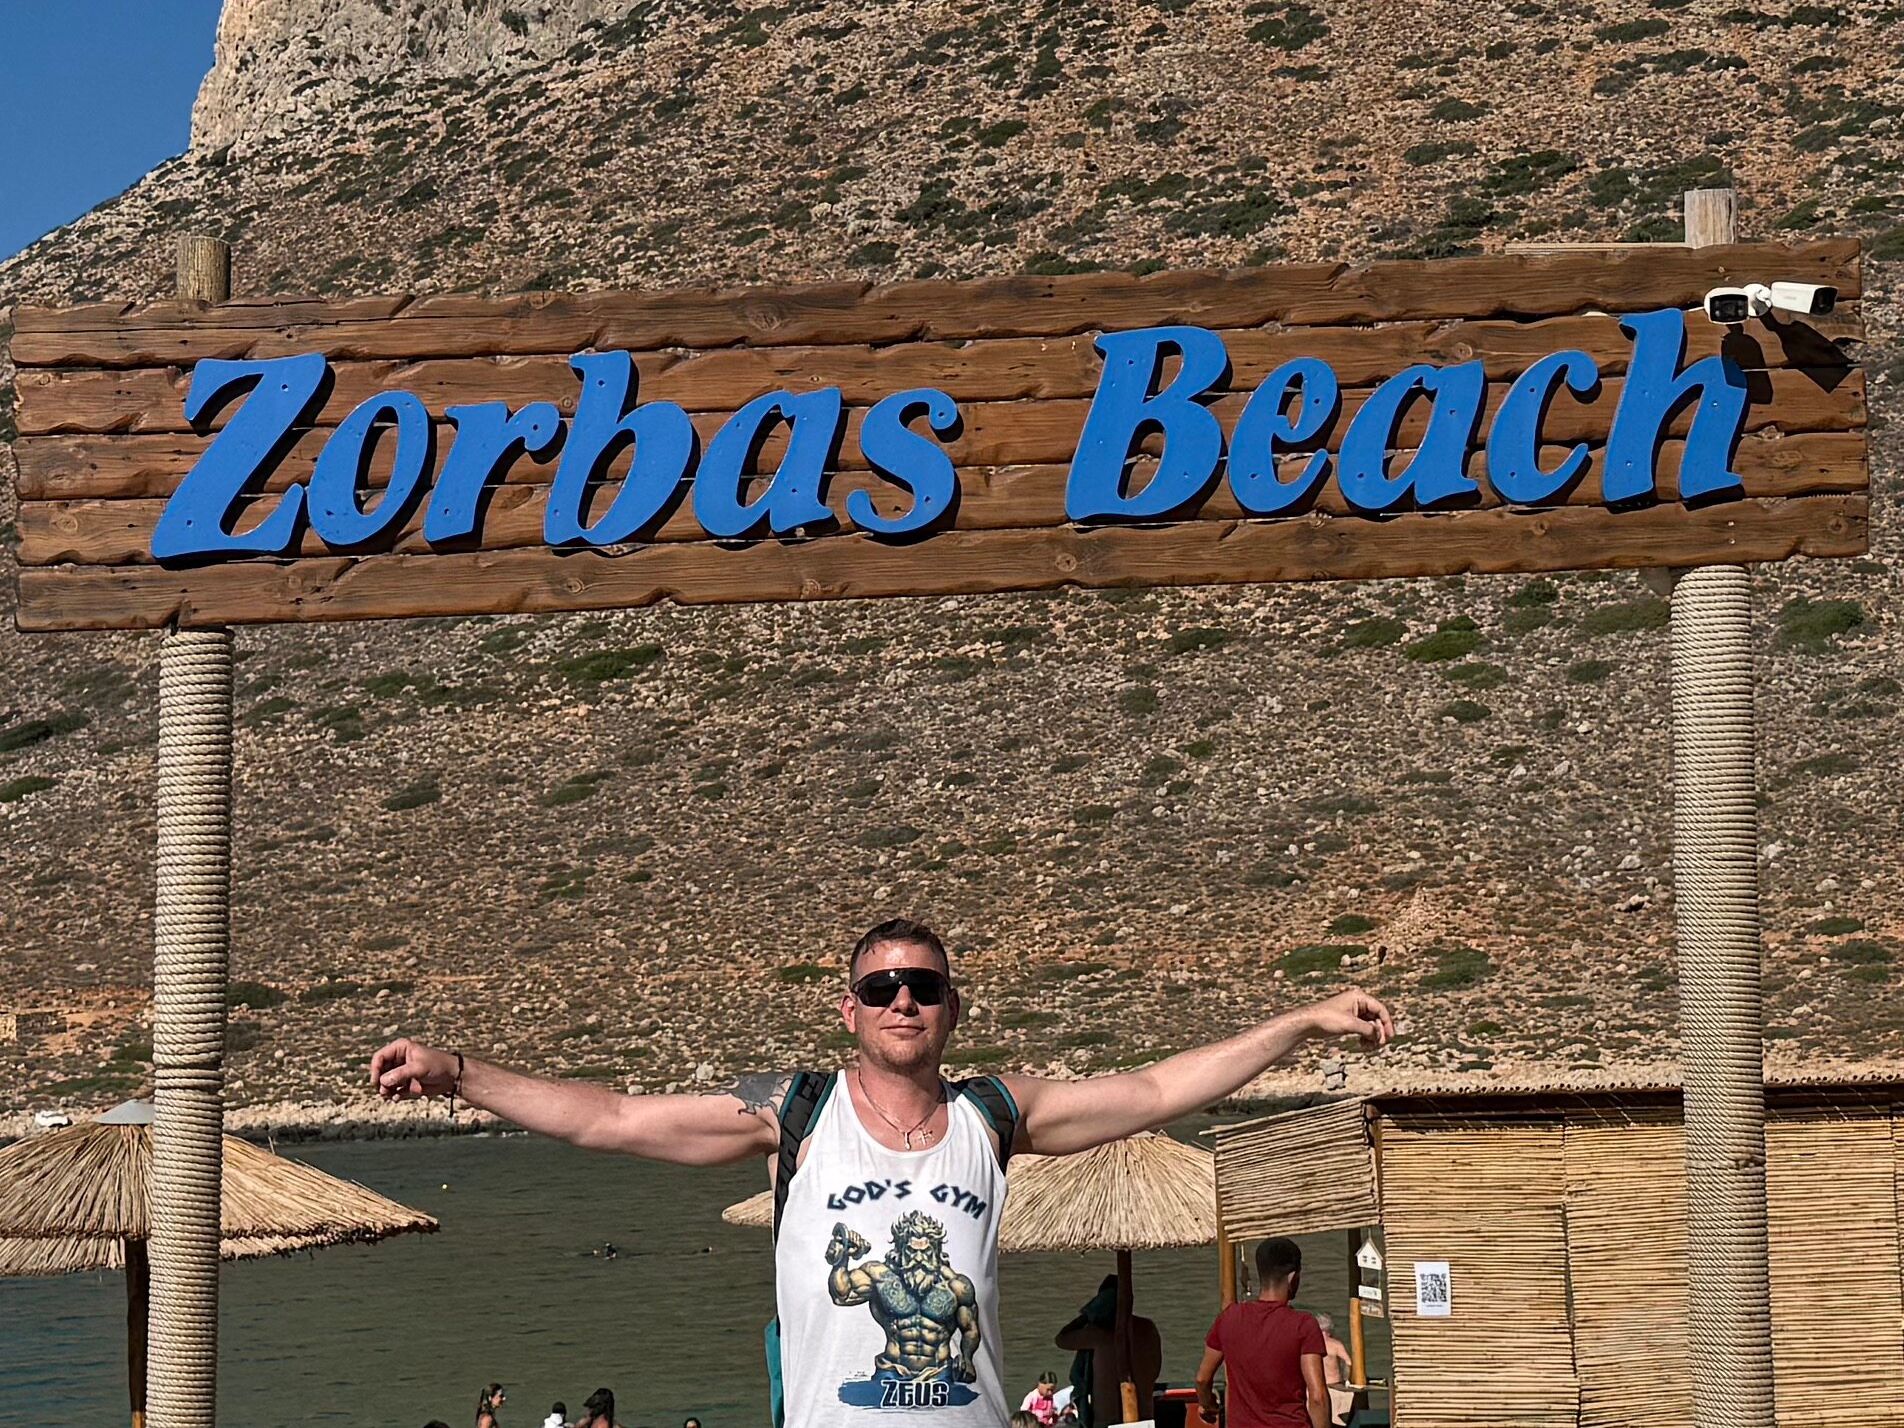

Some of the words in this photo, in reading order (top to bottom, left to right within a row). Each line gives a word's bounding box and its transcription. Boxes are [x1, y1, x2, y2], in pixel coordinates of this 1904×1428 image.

[151, 352, 962, 562] Zorbas
[1065, 309, 1743, 524] Beach
[827, 1178, 912, 1211] GOD'S
[929, 1183, 988, 1220] GYM
[880, 1379, 949, 1409] ZEUS
